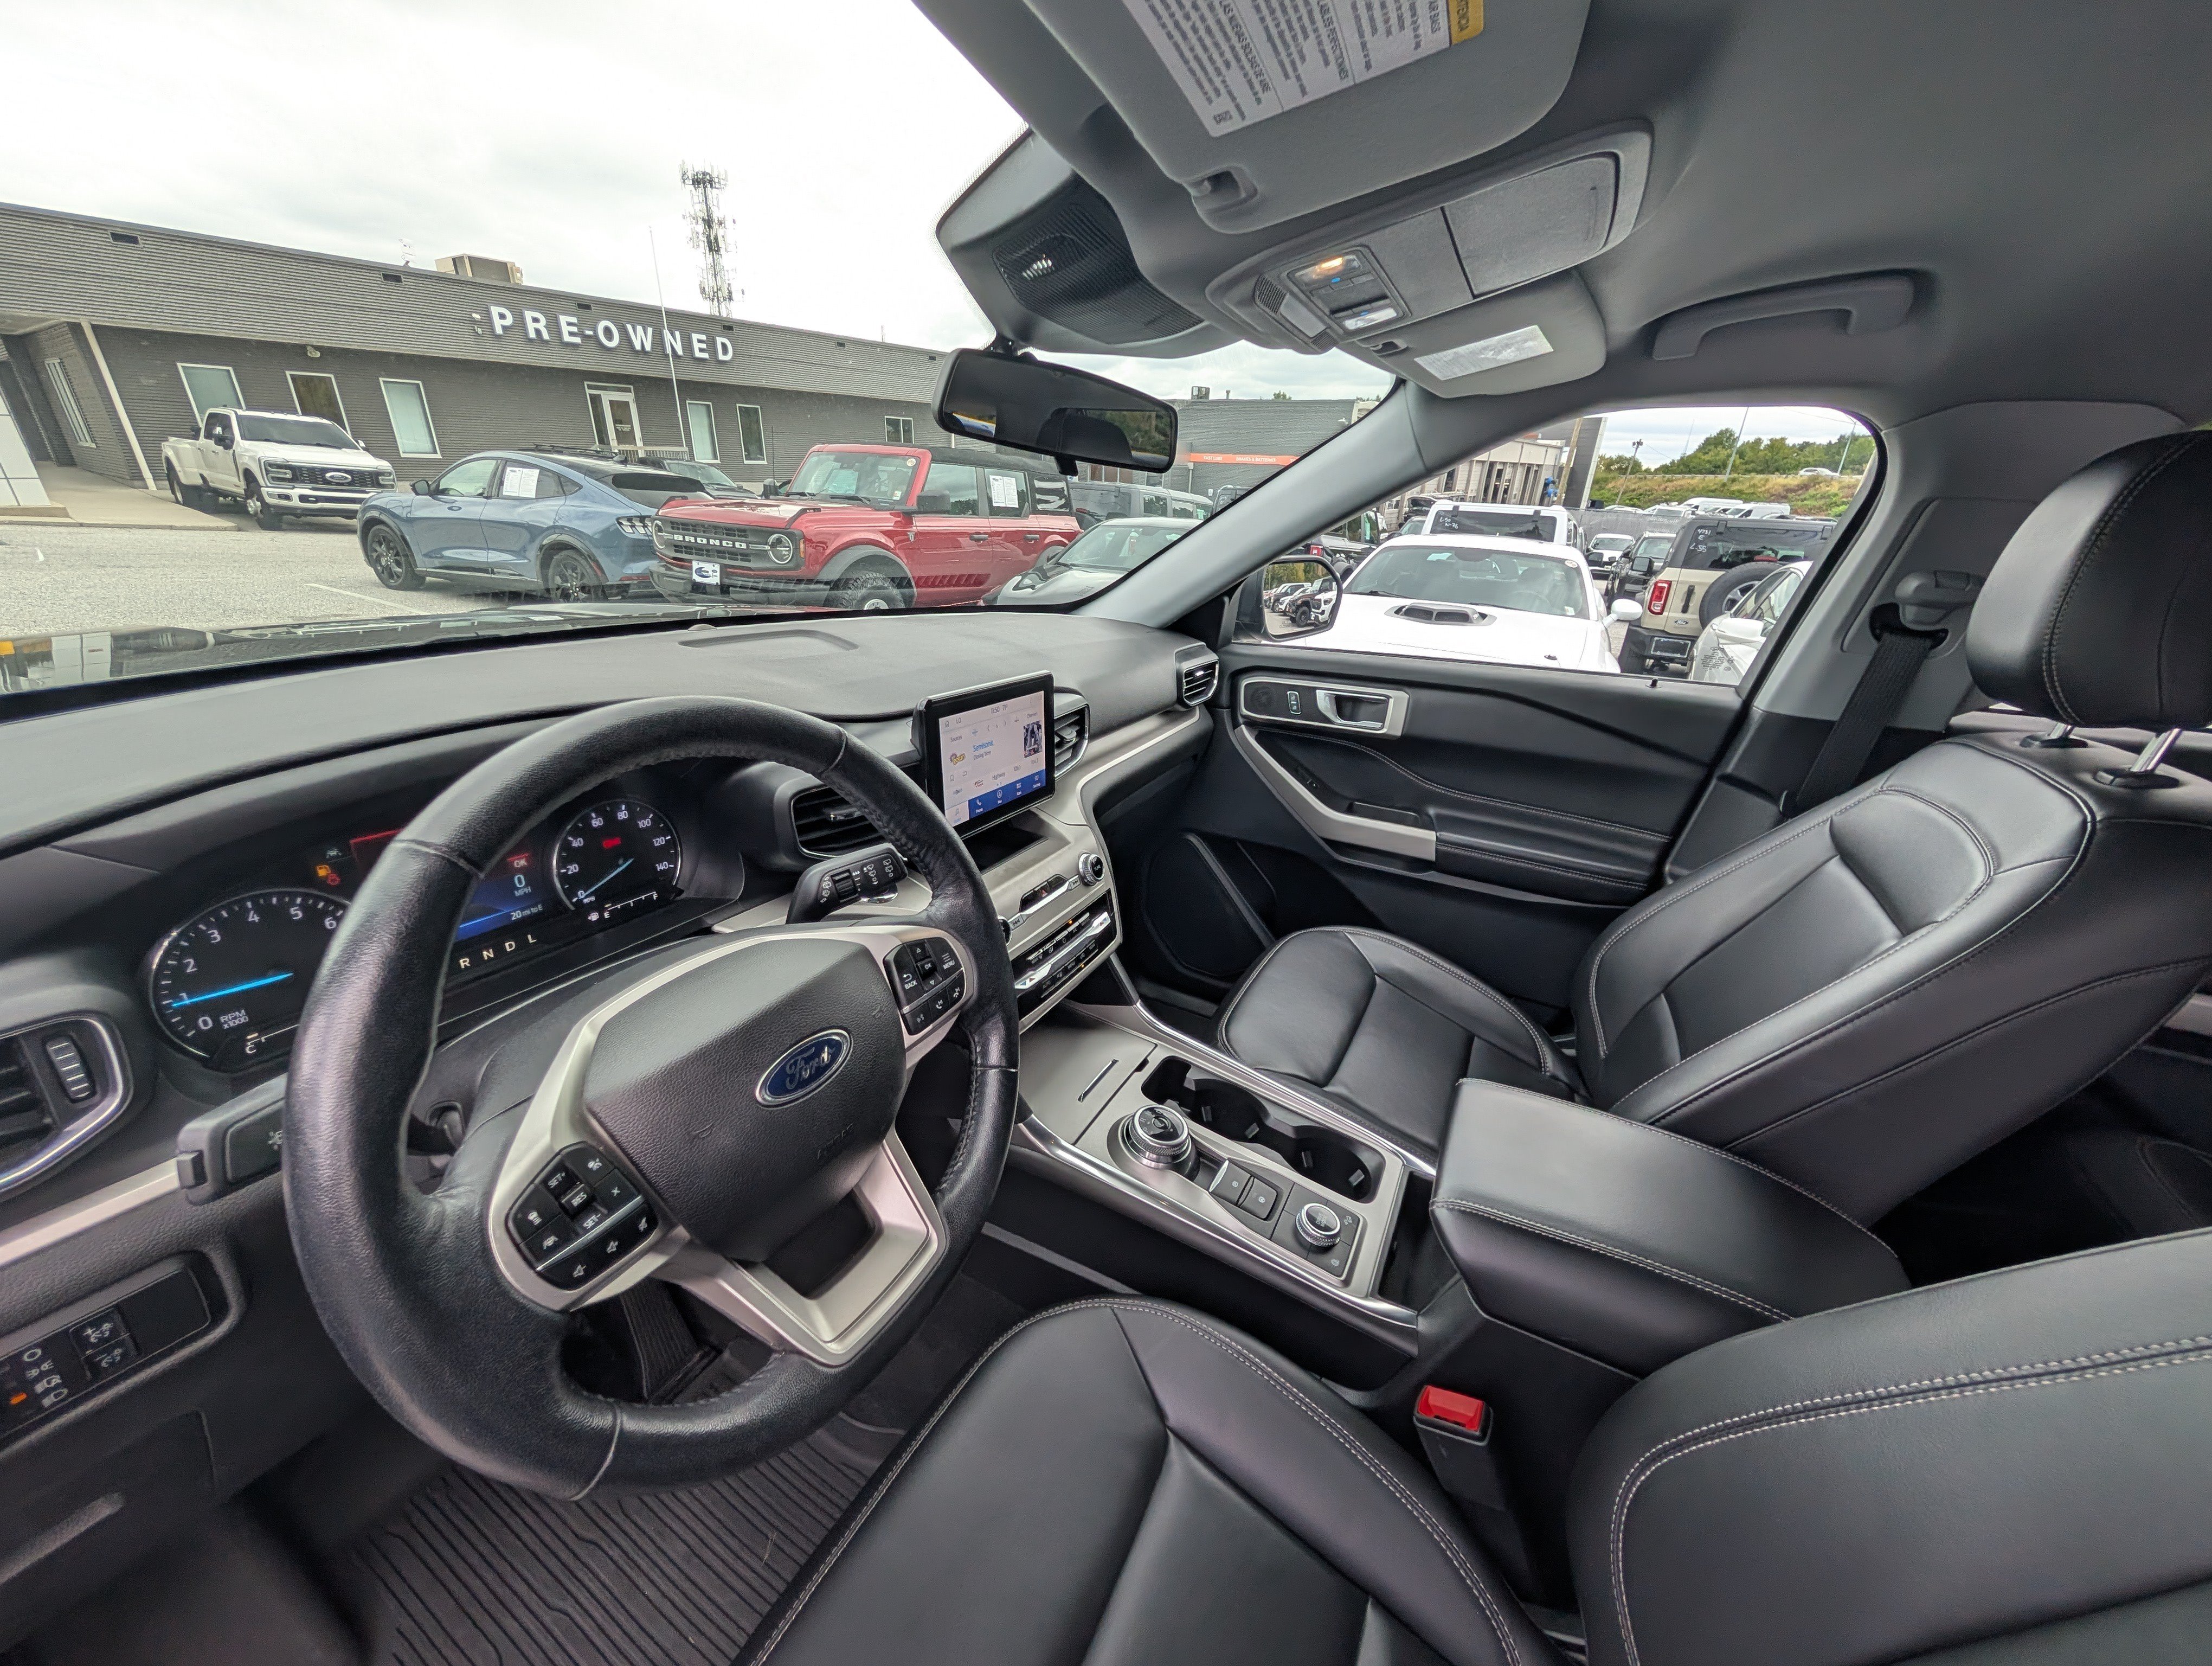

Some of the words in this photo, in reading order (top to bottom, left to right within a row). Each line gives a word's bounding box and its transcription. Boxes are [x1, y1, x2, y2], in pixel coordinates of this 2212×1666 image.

[489, 305, 734, 362] PRE-OWNED
[673, 534, 747, 549] BRONCO
[972, 740, 994, 752] Semisonic
[617, 811, 628, 820] 80
[591, 817, 603, 827] 60
[638, 818, 651, 828] 100
[572, 838, 583, 847] 40
[653, 837, 665, 847] 120
[514, 858, 527, 868] OK
[567, 864, 578, 874] 20
[655, 861, 668, 871] 140
[515, 874, 525, 887] 0
[514, 886, 531, 896] MPH
[248, 910, 260, 922] 4
[290, 906, 303, 920] 5
[511, 911, 522, 920] 20
[325, 917, 337, 929] 6
[208, 929, 221, 943] 3
[459, 958, 470, 969] R
[483, 949, 494, 960] N
[505, 941, 515, 952] D
[527, 934, 537, 943] L
[183, 958, 197, 972] 2
[943, 959, 955, 970] MENU
[904, 979, 917, 990] BACK
[220, 1009, 246, 1023] RPM
[198, 1016, 213, 1030] 0
[223, 1016, 249, 1029] x1000
[246, 1045, 256, 1054] C
[786, 1045, 835, 1090] Ford
[548, 1171, 565, 1189] SET+
[571, 1192, 587, 1207] RES
